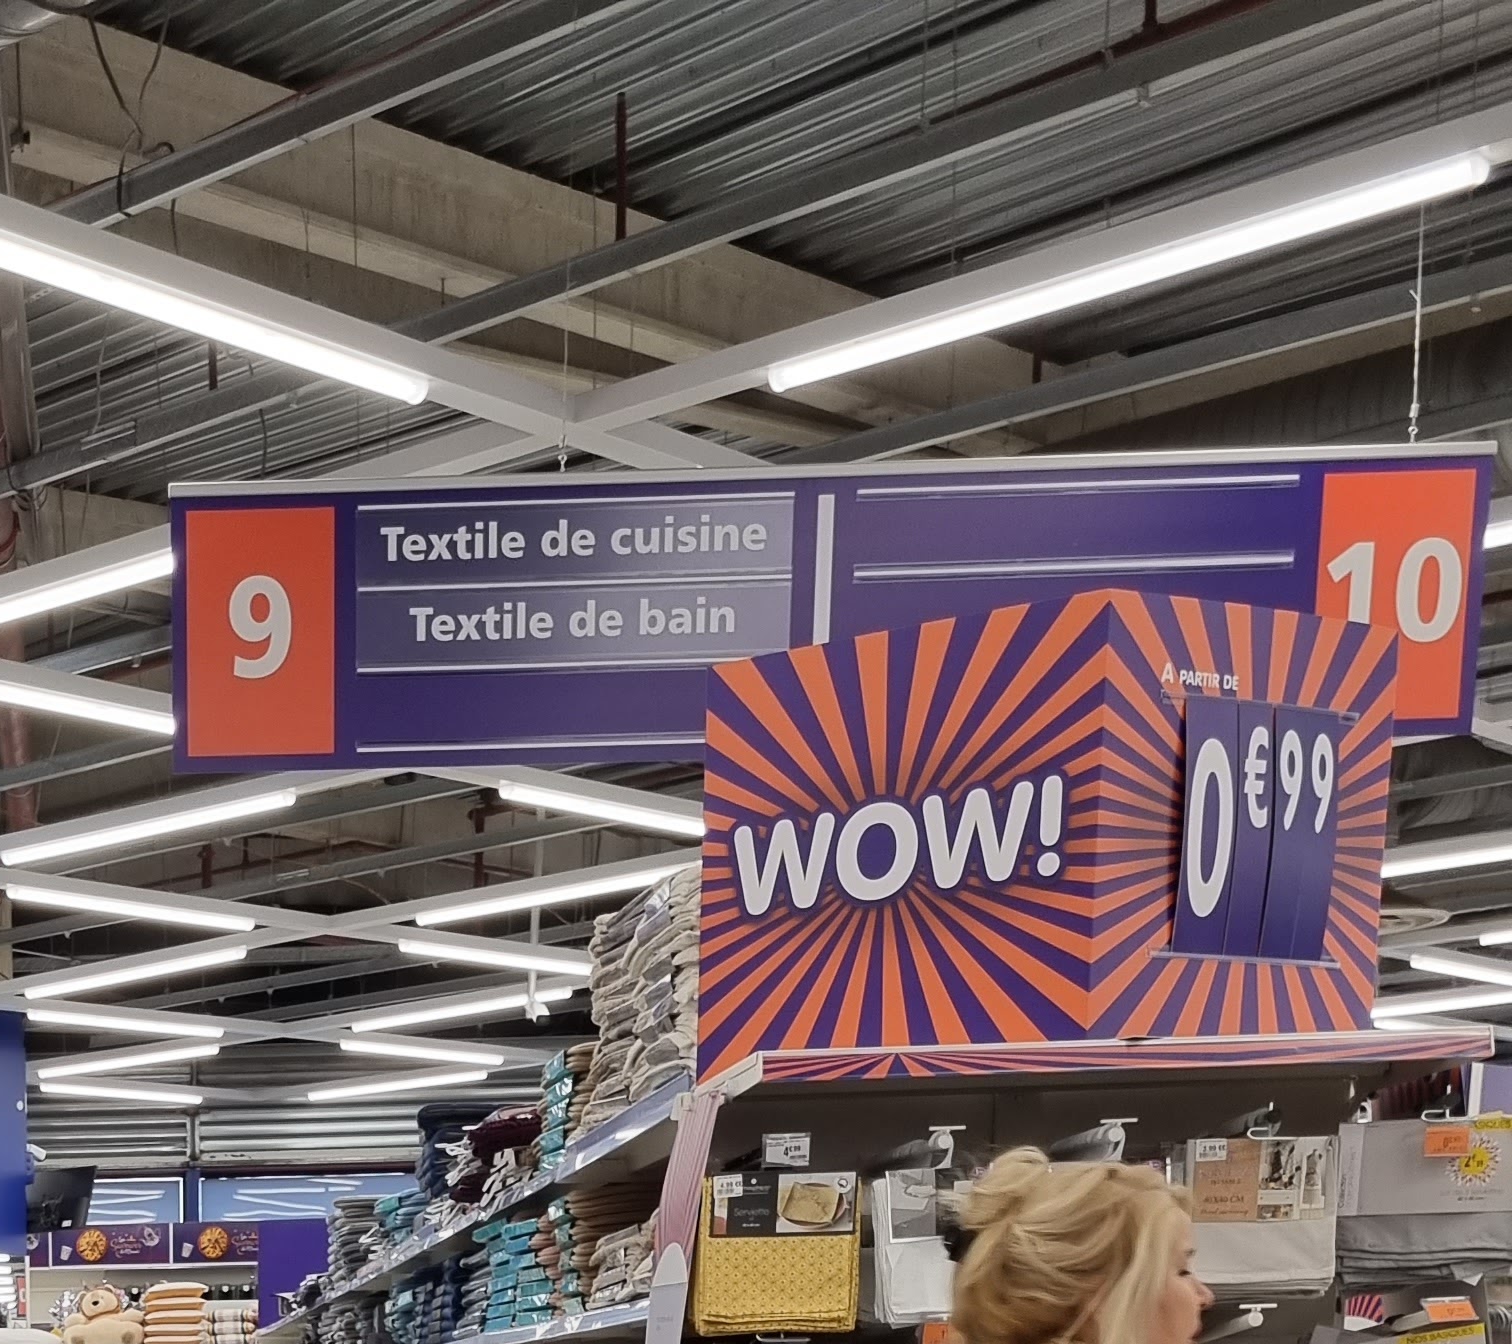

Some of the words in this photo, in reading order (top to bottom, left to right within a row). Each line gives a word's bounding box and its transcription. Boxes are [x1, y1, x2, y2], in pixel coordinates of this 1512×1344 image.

[380, 520, 526, 563] Textile
[541, 518, 597, 559] de
[611, 514, 768, 556] cuisine
[228, 574, 294, 680] 9
[409, 601, 555, 644] Textile
[568, 599, 624, 639] de
[638, 596, 736, 636] bain
[1325, 536, 1464, 643] 10
[1179, 669, 1220, 689] PARTIR
[1223, 674, 1240, 691] DE
[732, 774, 1064, 918] WOW!
